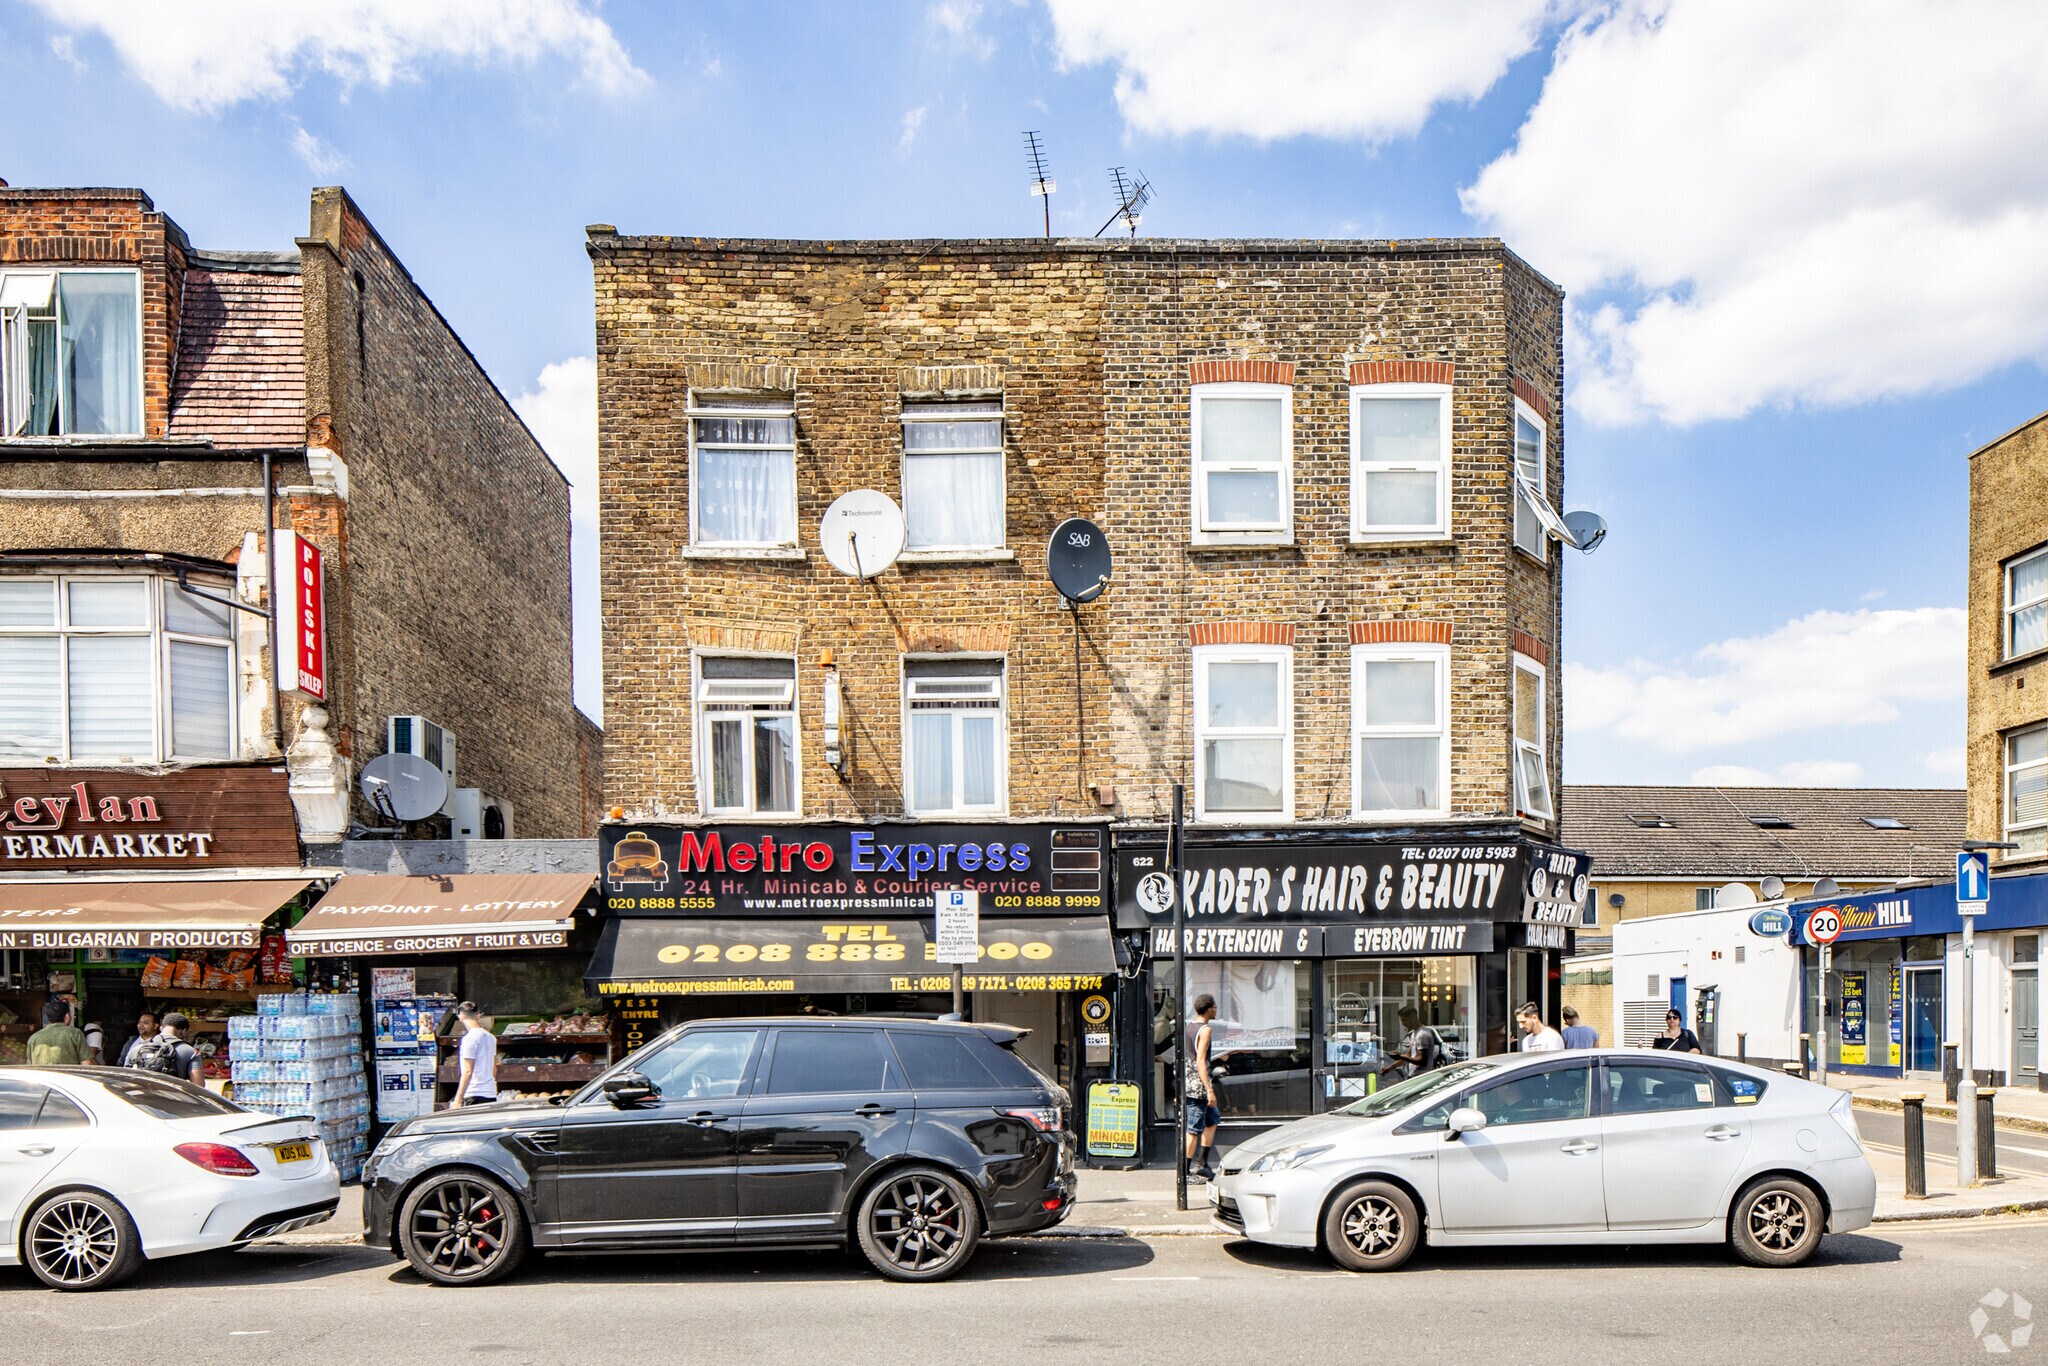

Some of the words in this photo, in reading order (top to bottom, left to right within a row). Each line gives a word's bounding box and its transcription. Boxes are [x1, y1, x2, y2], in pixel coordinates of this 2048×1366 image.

[848, 509, 882, 517] Technomate
[1067, 532, 1091, 547] SAB
[303, 545, 315, 670] POLSKI
[299, 669, 322, 695] SKLEP
[0, 781, 161, 831] eylan
[2, 833, 213, 859] ERMARKET
[1401, 847, 1425, 860] TEL:
[1428, 847, 1458, 860] 0207
[1461, 847, 1483, 859] 018
[1487, 846, 1517, 859] 5983
[678, 831, 834, 872] Metro
[850, 831, 1031, 881] Express
[1132, 856, 1154, 867] 622
[1548, 853, 1577, 877] HAIR
[684, 879, 712, 895] 24
[721, 879, 749, 895] Hr.
[764, 878, 847, 894] Minicab
[854, 879, 868, 894] &
[873, 877, 950, 894] Courier
[963, 877, 1041, 894] Service
[1183, 866, 1271, 918] KADER
[1277, 865, 1297, 913] S
[1301, 864, 1368, 914] HAIR
[1374, 864, 1393, 911] &
[1400, 863, 1505, 910] BEAUTY
[1555, 879, 1565, 898] &
[608, 897, 636, 910] 020
[639, 897, 676, 909] 8888
[680, 897, 716, 909] 5555
[953, 893, 962, 904] P
[994, 895, 1022, 908] 020
[1025, 895, 1061, 908] 8888
[1064, 895, 1102, 908] 9999
[1, 906, 84, 917] TERS
[318, 904, 438, 915] PAYPOINT
[460, 900, 565, 913] LOTTERY
[1535, 901, 1577, 923] BEAUTY
[1878, 899, 1913, 926] HILL
[1762, 922, 1783, 932] HILL
[1814, 917, 1839, 932] 20
[0, 932, 16, 947] N
[33, 931, 140, 947] BULGARIAN
[150, 931, 254, 947] PRODUCTS
[822, 925, 897, 941] TEL
[1155, 928, 1194, 954] HAR
[1196, 928, 1283, 953] EXTENSION
[1296, 927, 1309, 952] &
[1354, 925, 1428, 952] EYEBROW
[1430, 924, 1467, 949] TINT
[290, 943, 319, 955] OFF
[321, 940, 384, 954] LICENCE
[394, 935, 463, 951] GROCERY
[475, 934, 516, 948] FRUIT
[519, 934, 530, 946] &
[534, 932, 563, 945] VEG
[657, 943, 792, 964] 0208
[805, 942, 906, 962] 888
[376, 981, 413, 994] FUNFAIR
[377, 974, 408, 985] FAMILY
[598, 977, 795, 995] www.metroexpressminicab.com
[890, 977, 912, 991] TEL
[920, 976, 952, 991] 0208
[979, 976, 1008, 990] 7171
[1016, 975, 1047, 990] 0208
[1049, 975, 1072, 989] 365
[1073, 974, 1103, 989] 7374
[1844, 980, 1857, 988] free
[1852, 987, 1863, 996] bet
[613, 998, 659, 1008] TEST
[1111, 1096, 1137, 1104] Express
[1089, 1131, 1135, 1143] MINICAB
